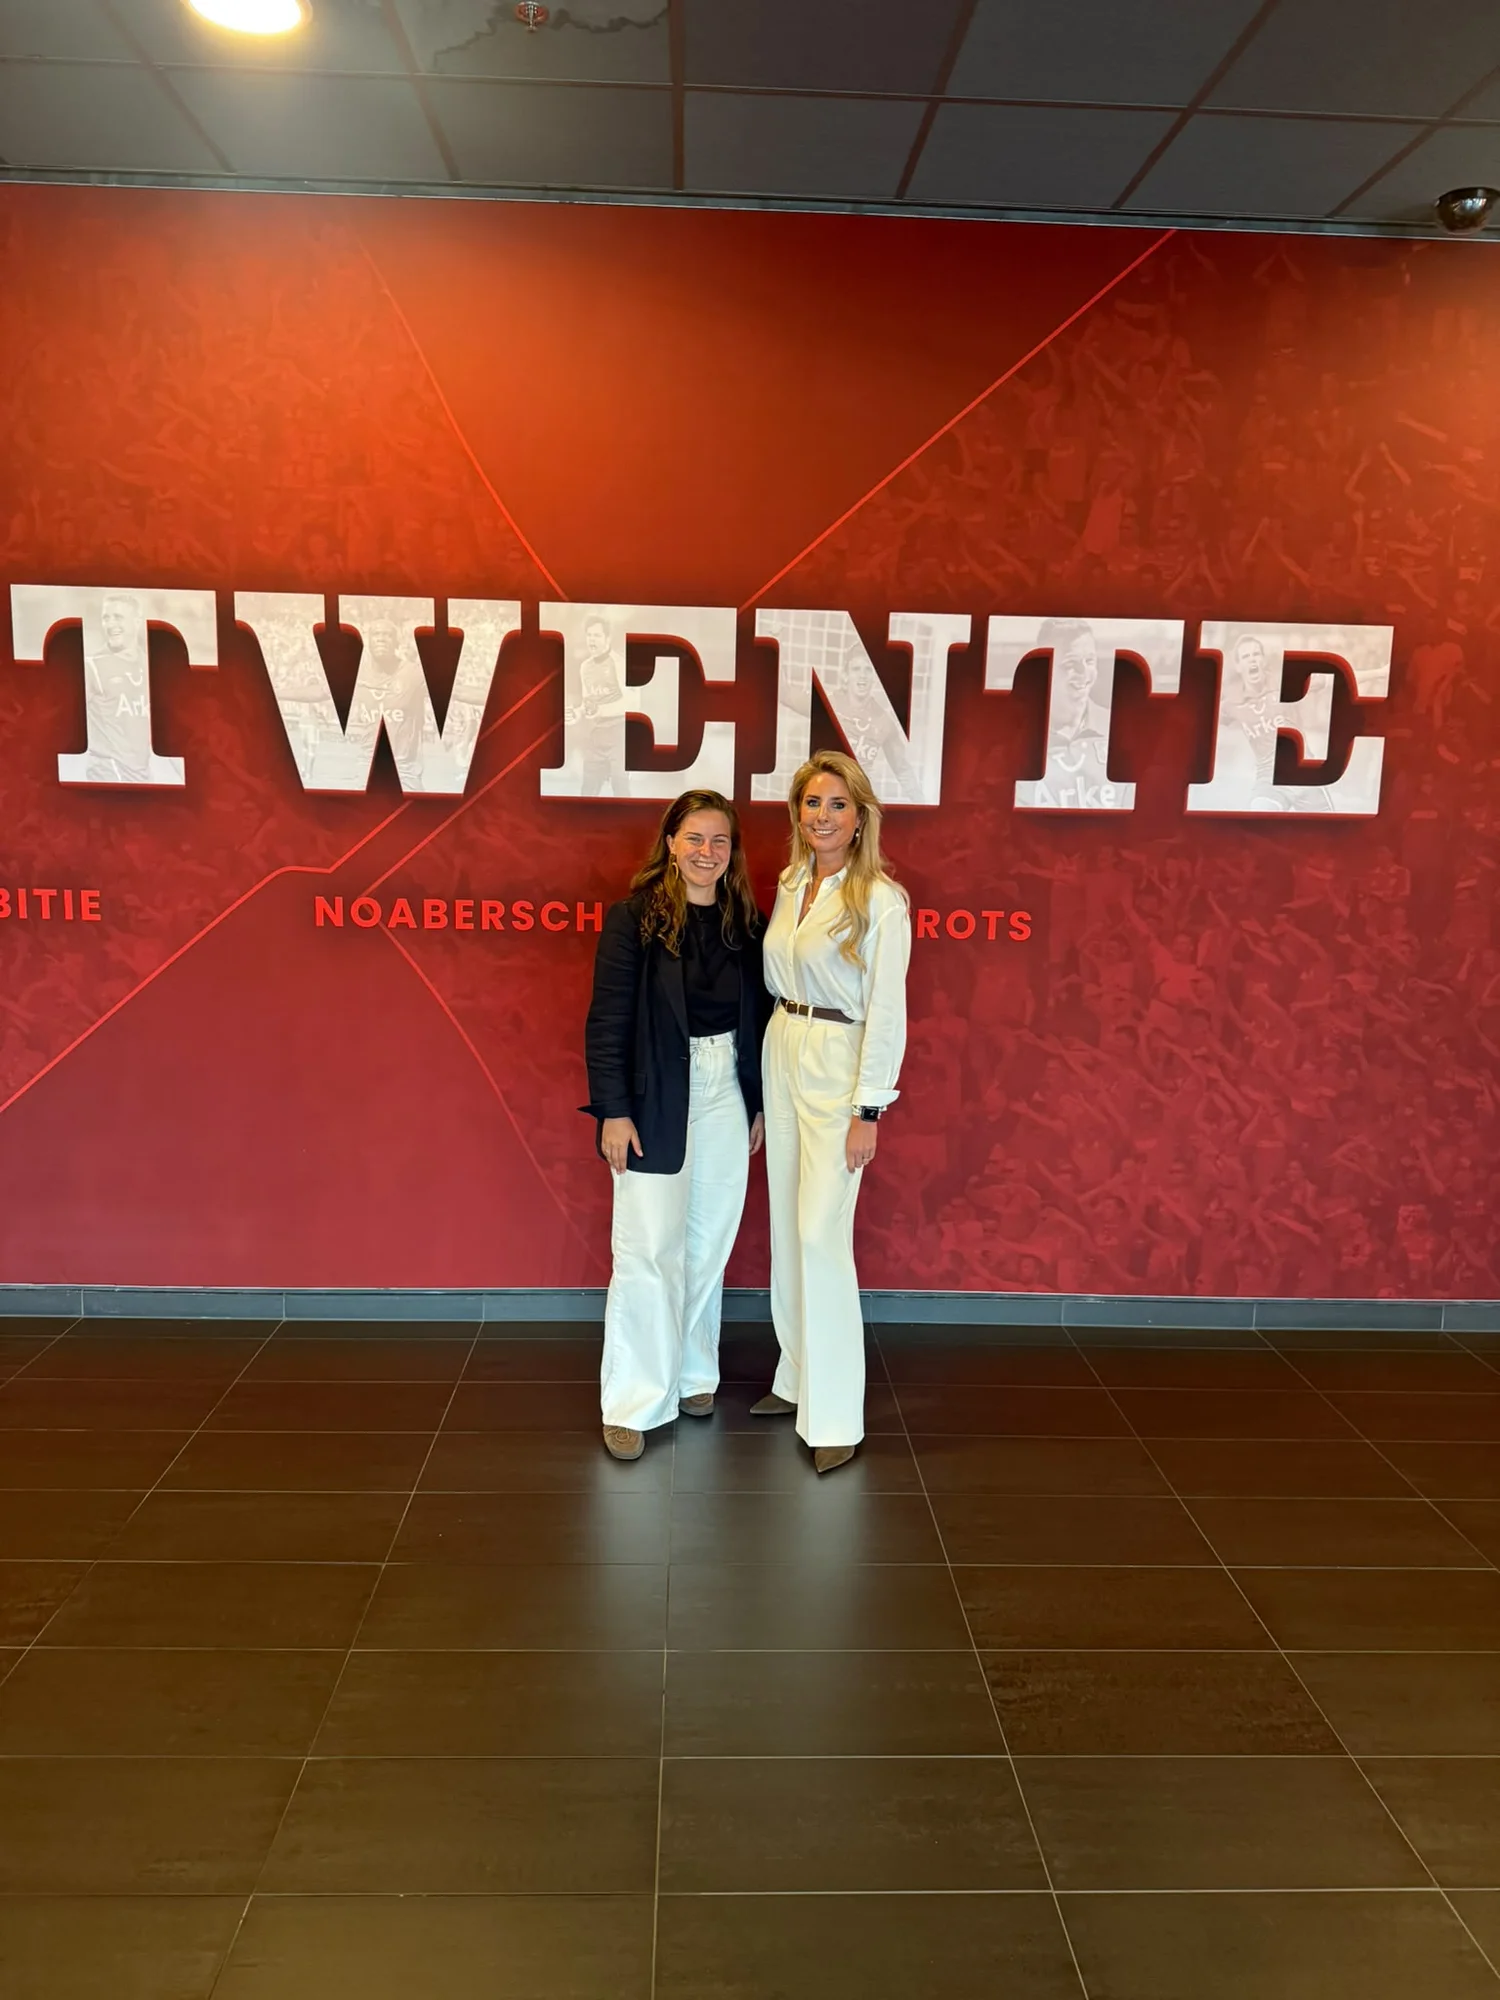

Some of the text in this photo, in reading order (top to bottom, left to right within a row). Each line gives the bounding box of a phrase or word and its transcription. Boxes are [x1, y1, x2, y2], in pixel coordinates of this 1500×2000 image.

[10, 583, 1394, 816] TWENTE
[361, 702, 404, 722] Arke
[1242, 715, 1285, 738] Arke
[1034, 776, 1116, 809] Arke
[315, 896, 603, 931] NOABERSCH
[908, 908, 1032, 941] ROTS
